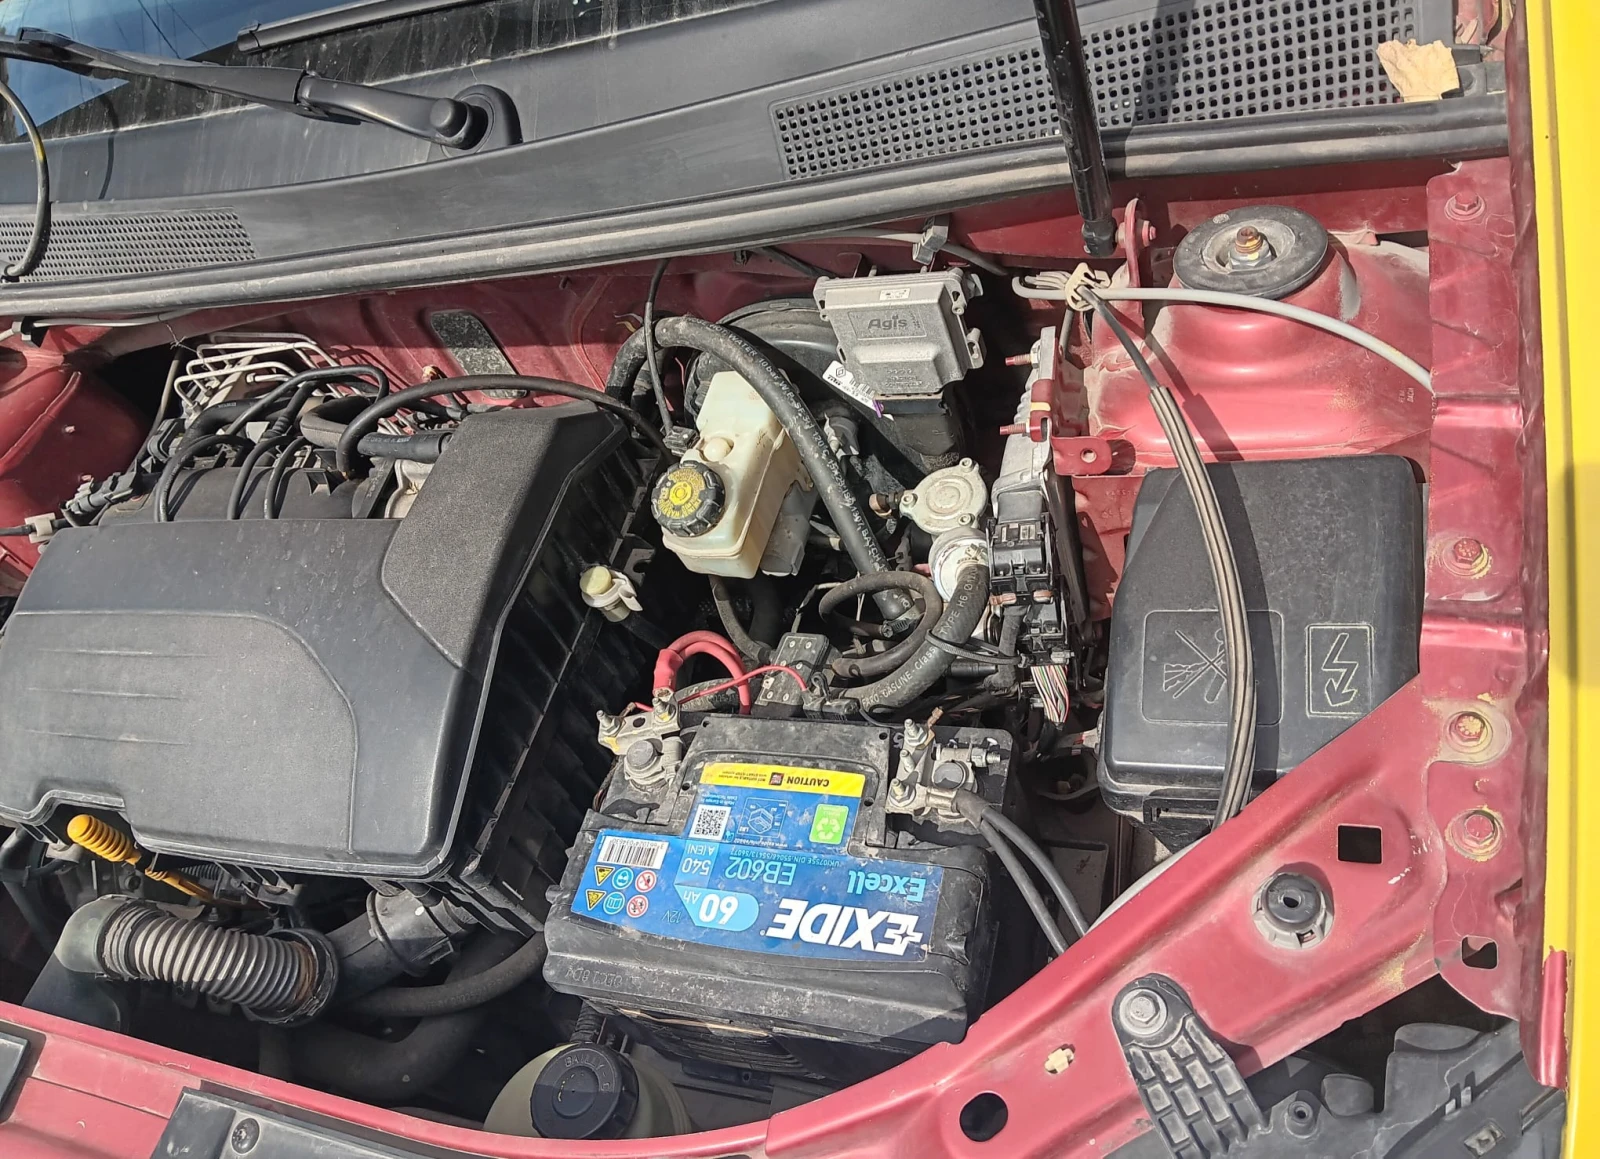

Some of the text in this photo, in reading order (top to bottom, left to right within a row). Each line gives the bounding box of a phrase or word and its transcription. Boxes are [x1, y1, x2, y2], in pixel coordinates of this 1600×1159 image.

[868, 314, 908, 330] Agis
[728, 333, 757, 356] WATER
[861, 529, 882, 562] BATCH
[940, 610, 960, 635] TYPE
[956, 594, 968, 608] H6
[786, 776, 829, 787] CAUTION
[681, 857, 711, 876] 540
[723, 856, 796, 886] EB602
[846, 870, 926, 902] Excell
[661, 909, 681, 924] 12V
[682, 890, 738, 926] 60 Ah
[764, 897, 922, 956] EXIDE
